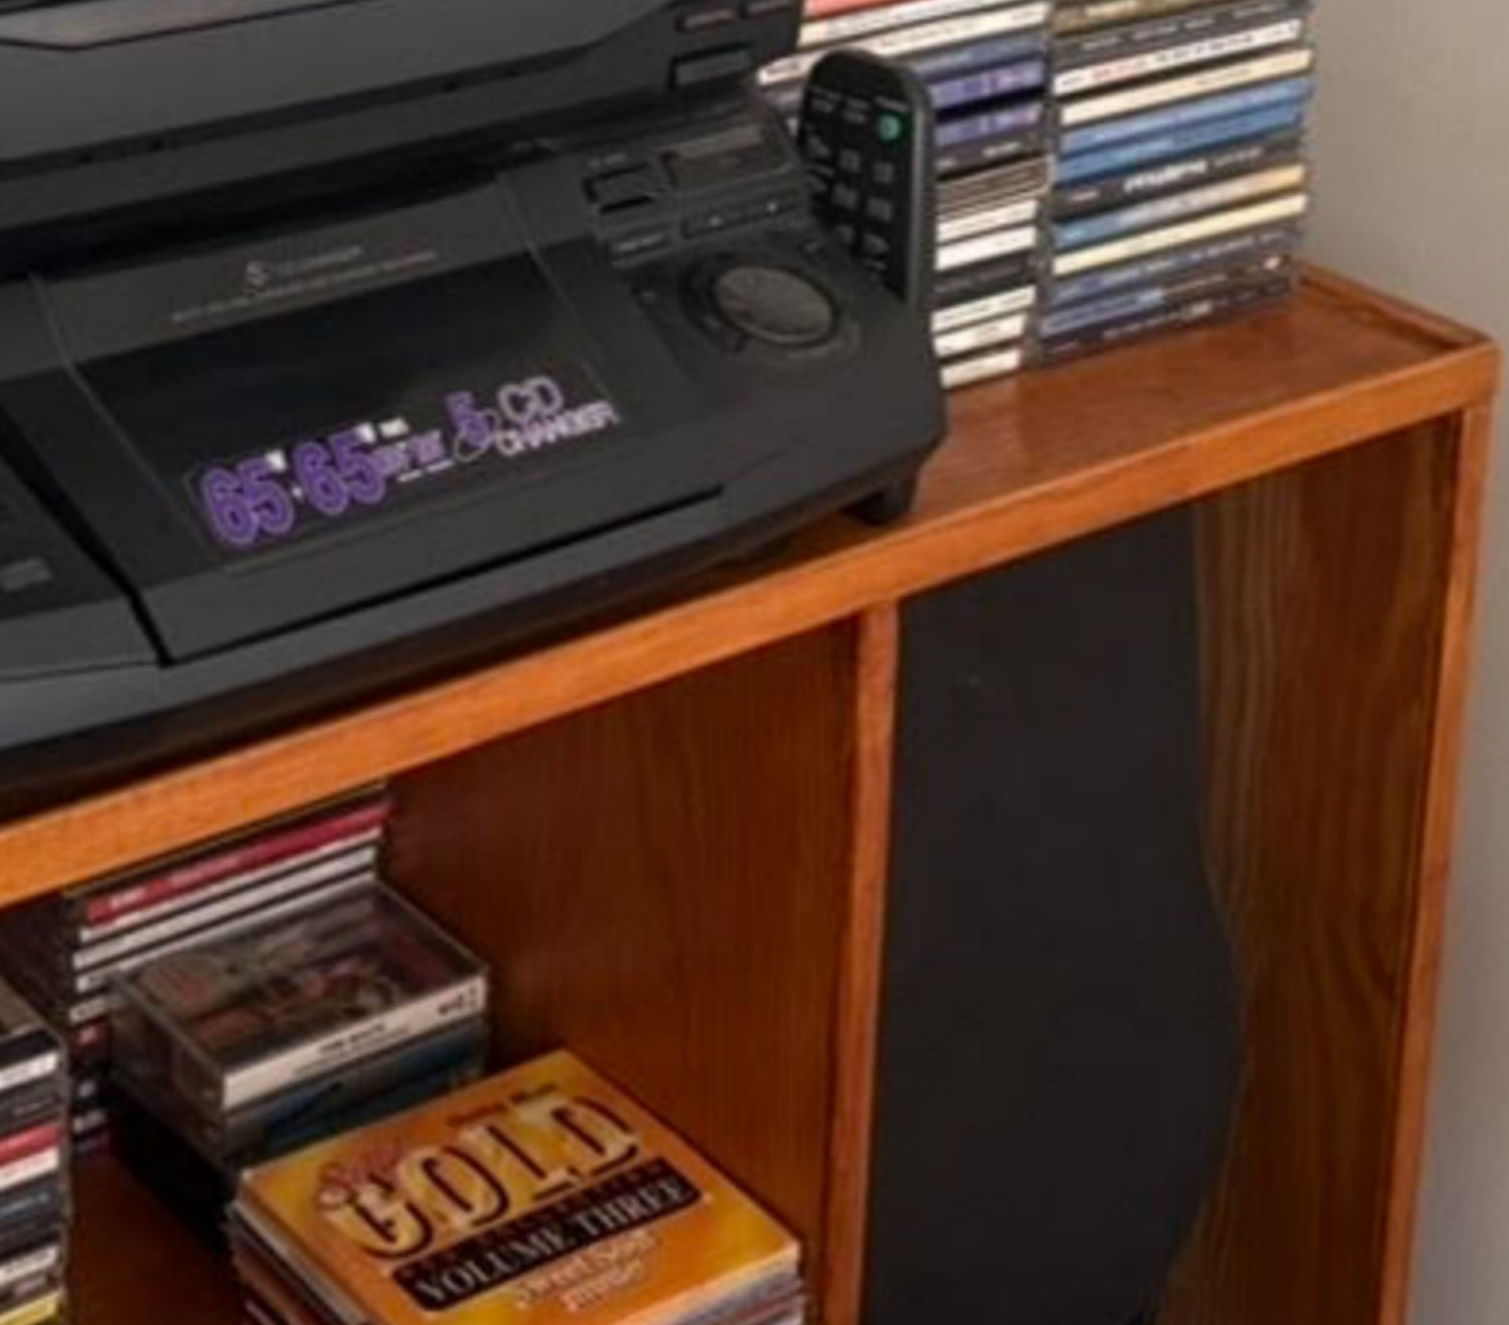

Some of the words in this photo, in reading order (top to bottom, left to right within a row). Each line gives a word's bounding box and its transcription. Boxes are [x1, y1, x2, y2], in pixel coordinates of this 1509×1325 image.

[494, 400, 617, 457] CHANGER
[498, 376, 563, 422] CD
[322, 1095, 644, 1261] GOLD
[414, 1225, 578, 1305] VOLUME
[576, 1176, 688, 1240] THREE
